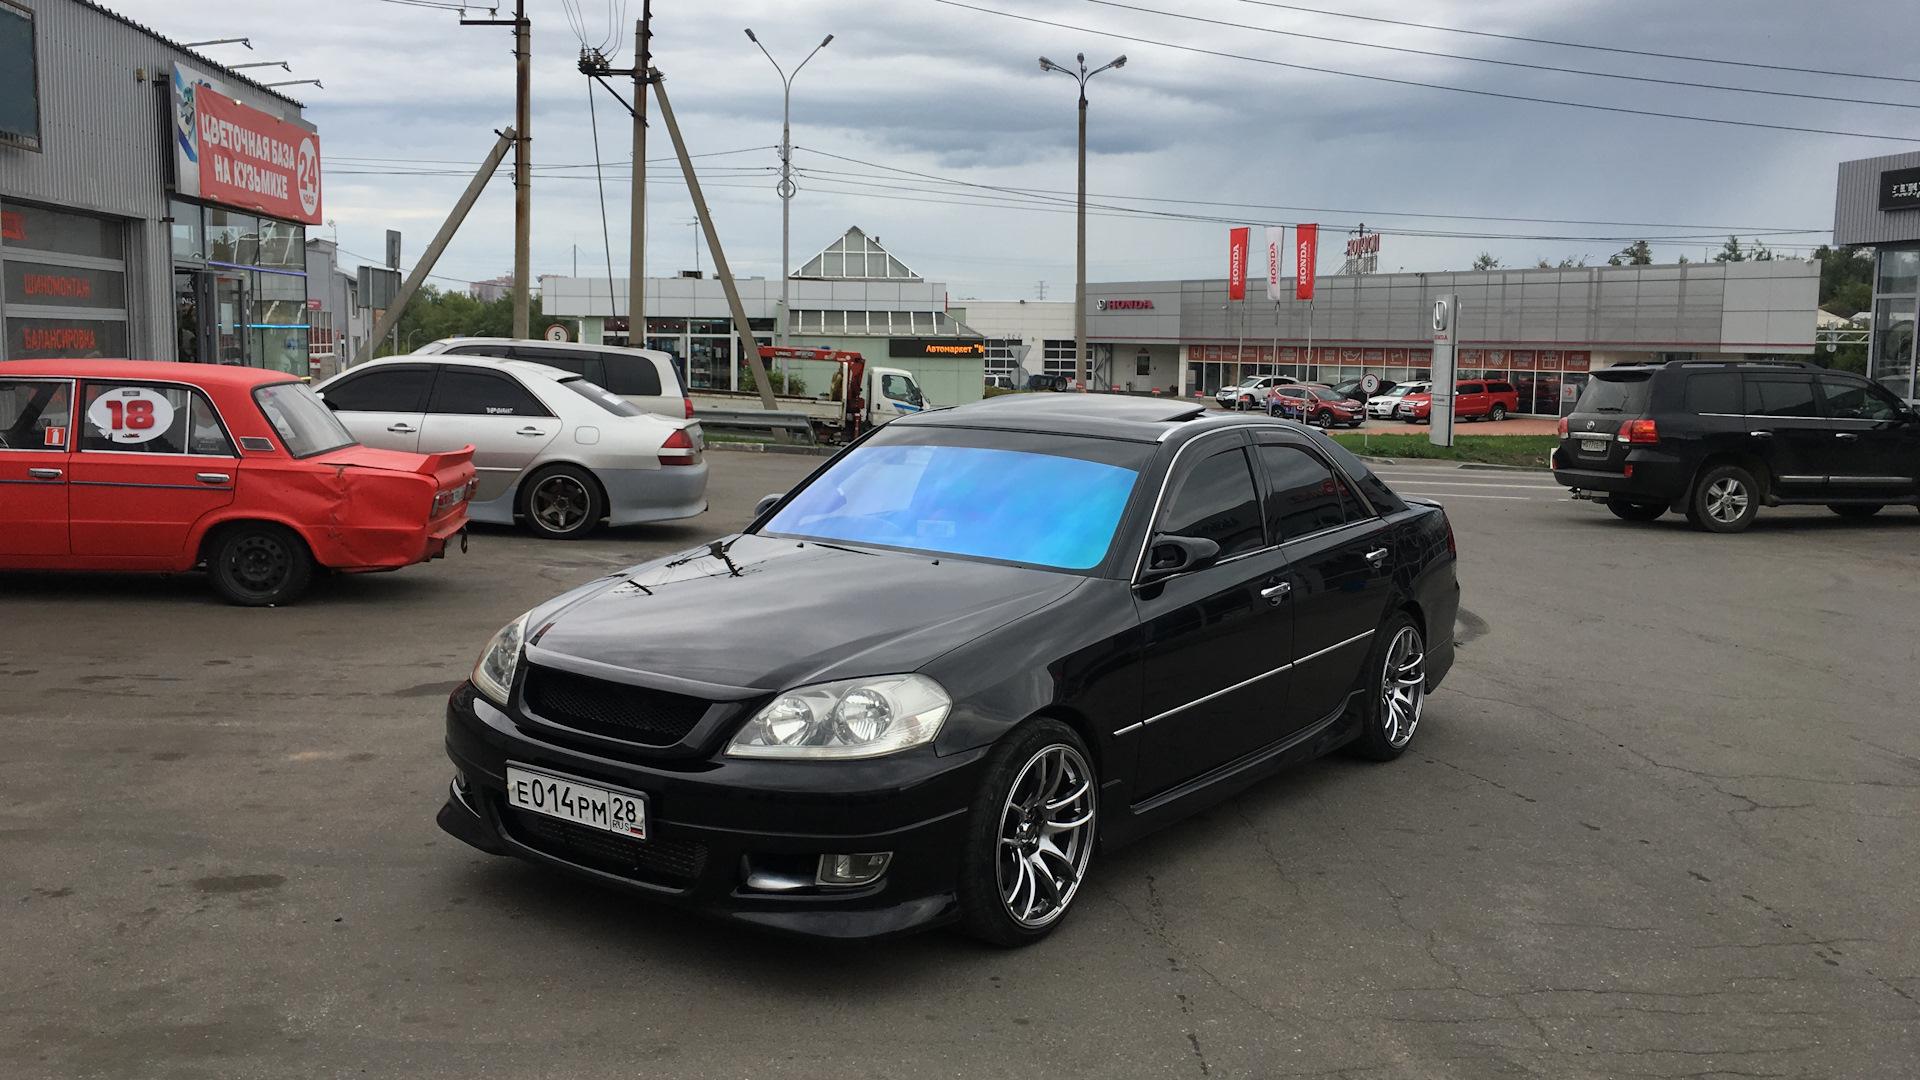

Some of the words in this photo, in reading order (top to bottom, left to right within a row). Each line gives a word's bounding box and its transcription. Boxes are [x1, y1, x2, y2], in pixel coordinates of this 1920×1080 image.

[201, 112, 270, 162] ЦВЕТОЧНАЯ
[271, 139, 295, 170] БАЗА
[214, 154, 232, 185] НА
[233, 160, 288, 200] КУЗЬМИХЕ
[299, 151, 318, 193] 24
[1269, 241, 1277, 285] HONDA
[1300, 241, 1308, 285] HONDA
[24, 272, 92, 298] ШИНОМОНТАЖ
[1109, 299, 1154, 310] HONDA
[24, 328, 97, 351] БАЛАНСИРОВКА
[554, 331, 561, 341] 5
[926, 345, 973, 354] Автомаркет
[1366, 380, 1373, 388] 5
[106, 400, 155, 430] 18
[517, 778, 608, 825] Е014РМ
[613, 797, 636, 823] 28
[612, 819, 630, 832] RUS
